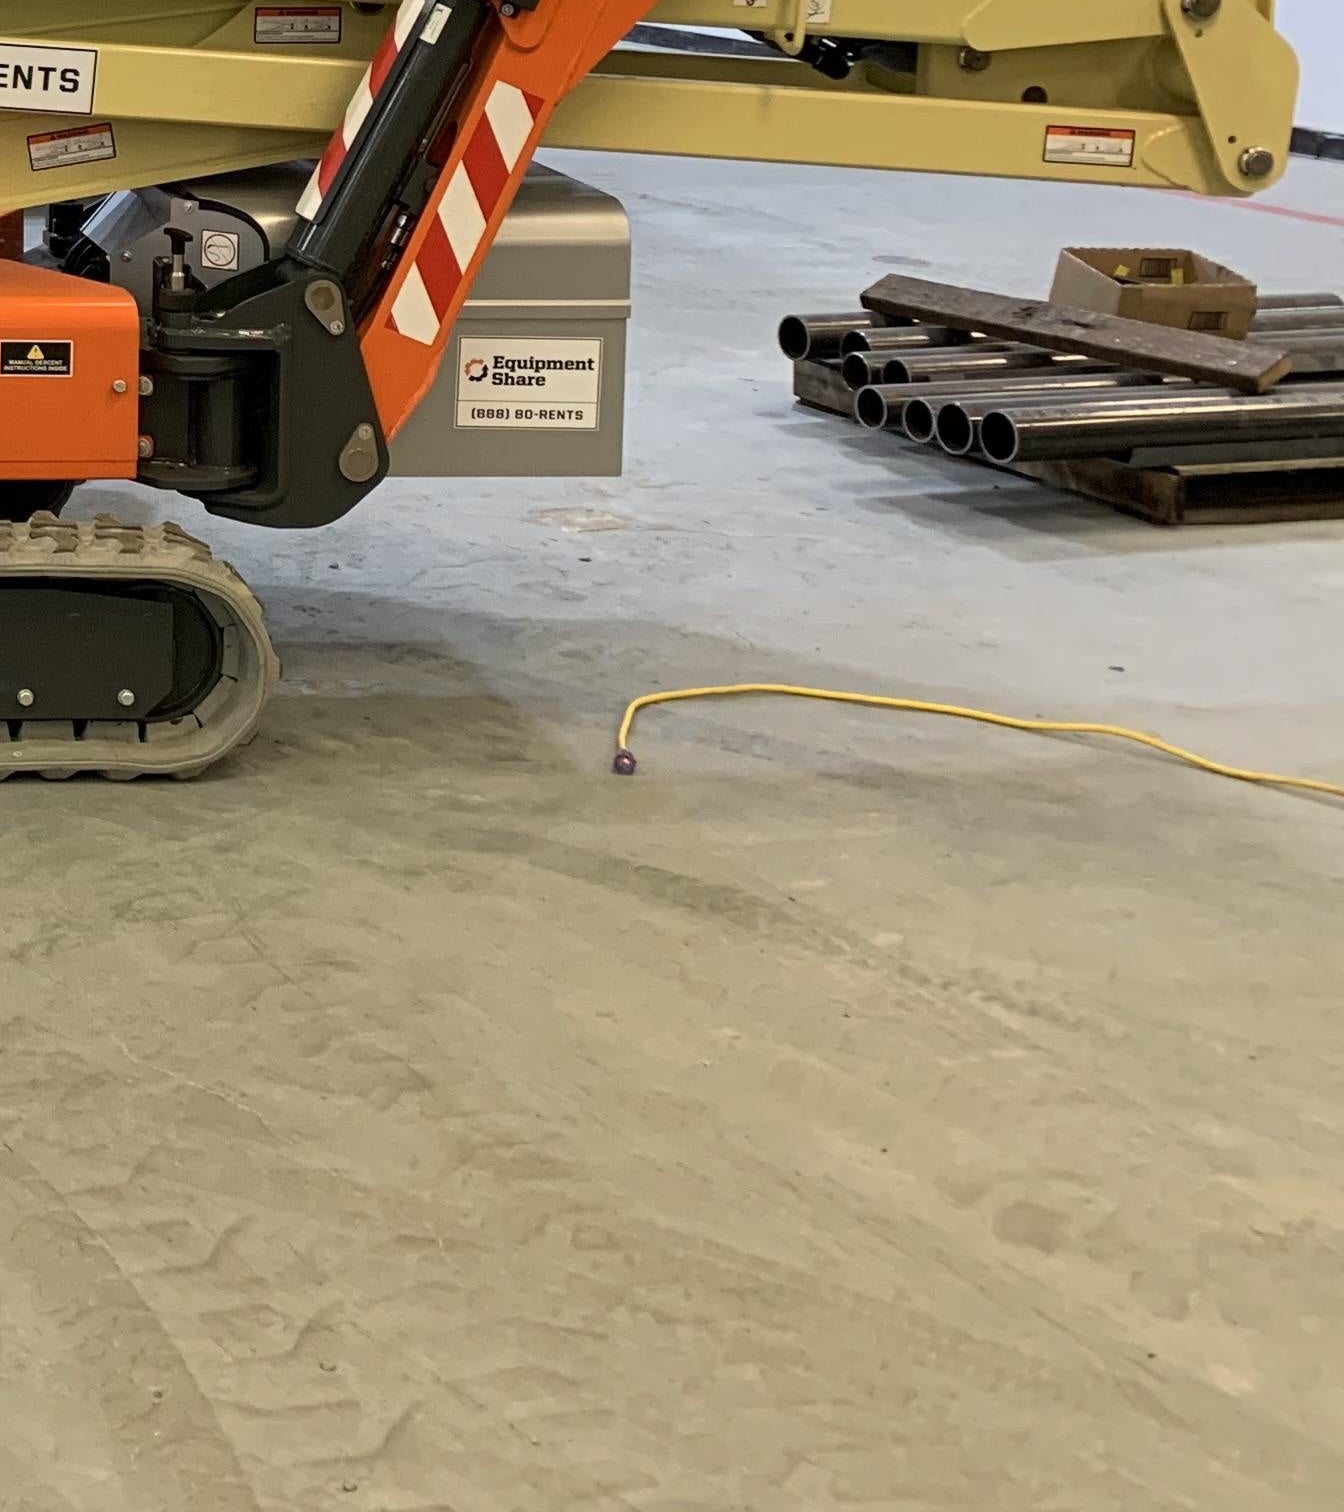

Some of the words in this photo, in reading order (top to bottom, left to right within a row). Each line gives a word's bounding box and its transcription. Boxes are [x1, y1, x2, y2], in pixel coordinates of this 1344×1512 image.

[492, 355, 595, 373] Equipment
[491, 373, 546, 387] Share
[471, 407, 510, 420] (888)
[514, 408, 584, 421] 80-RENTS
